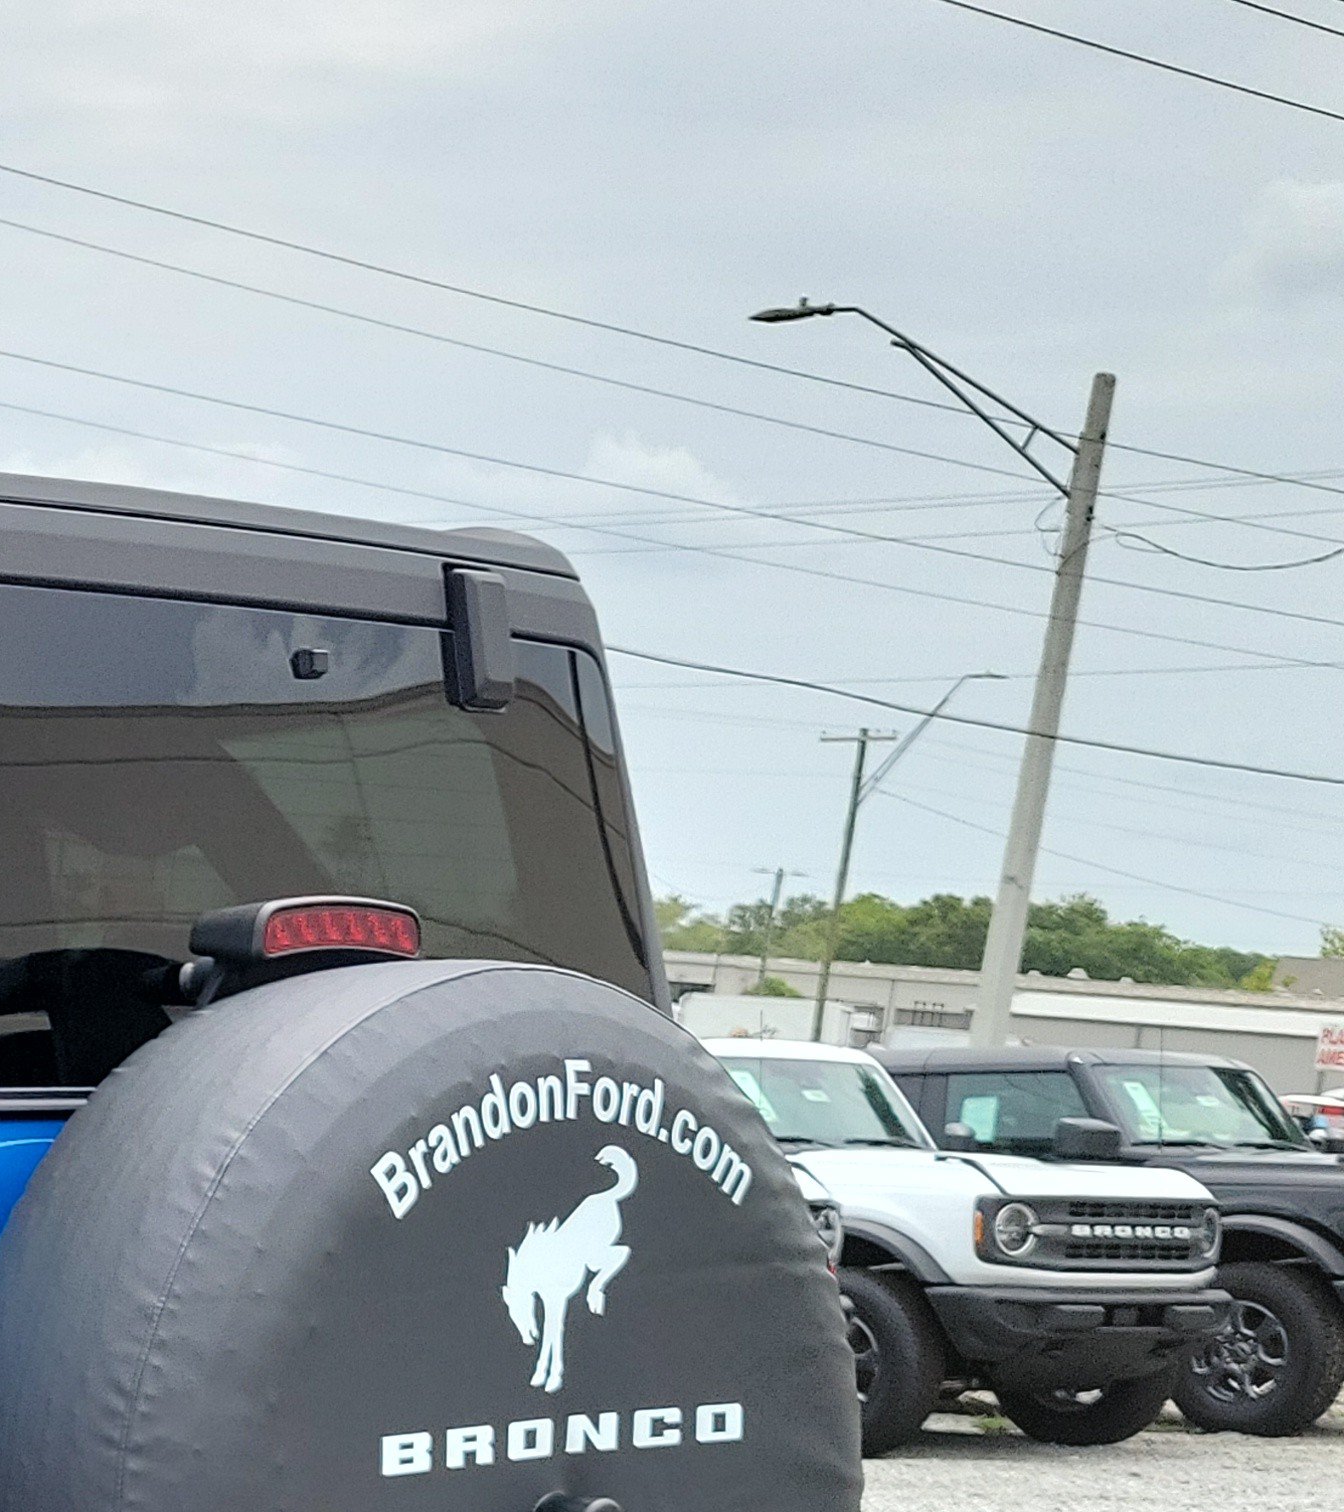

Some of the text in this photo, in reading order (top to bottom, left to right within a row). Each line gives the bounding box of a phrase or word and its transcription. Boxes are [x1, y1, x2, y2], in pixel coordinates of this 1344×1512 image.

[369, 1058, 754, 1220] BrandonFord.com
[1071, 1223, 1191, 1240] BRONCO
[380, 1402, 744, 1478] BRONCO
